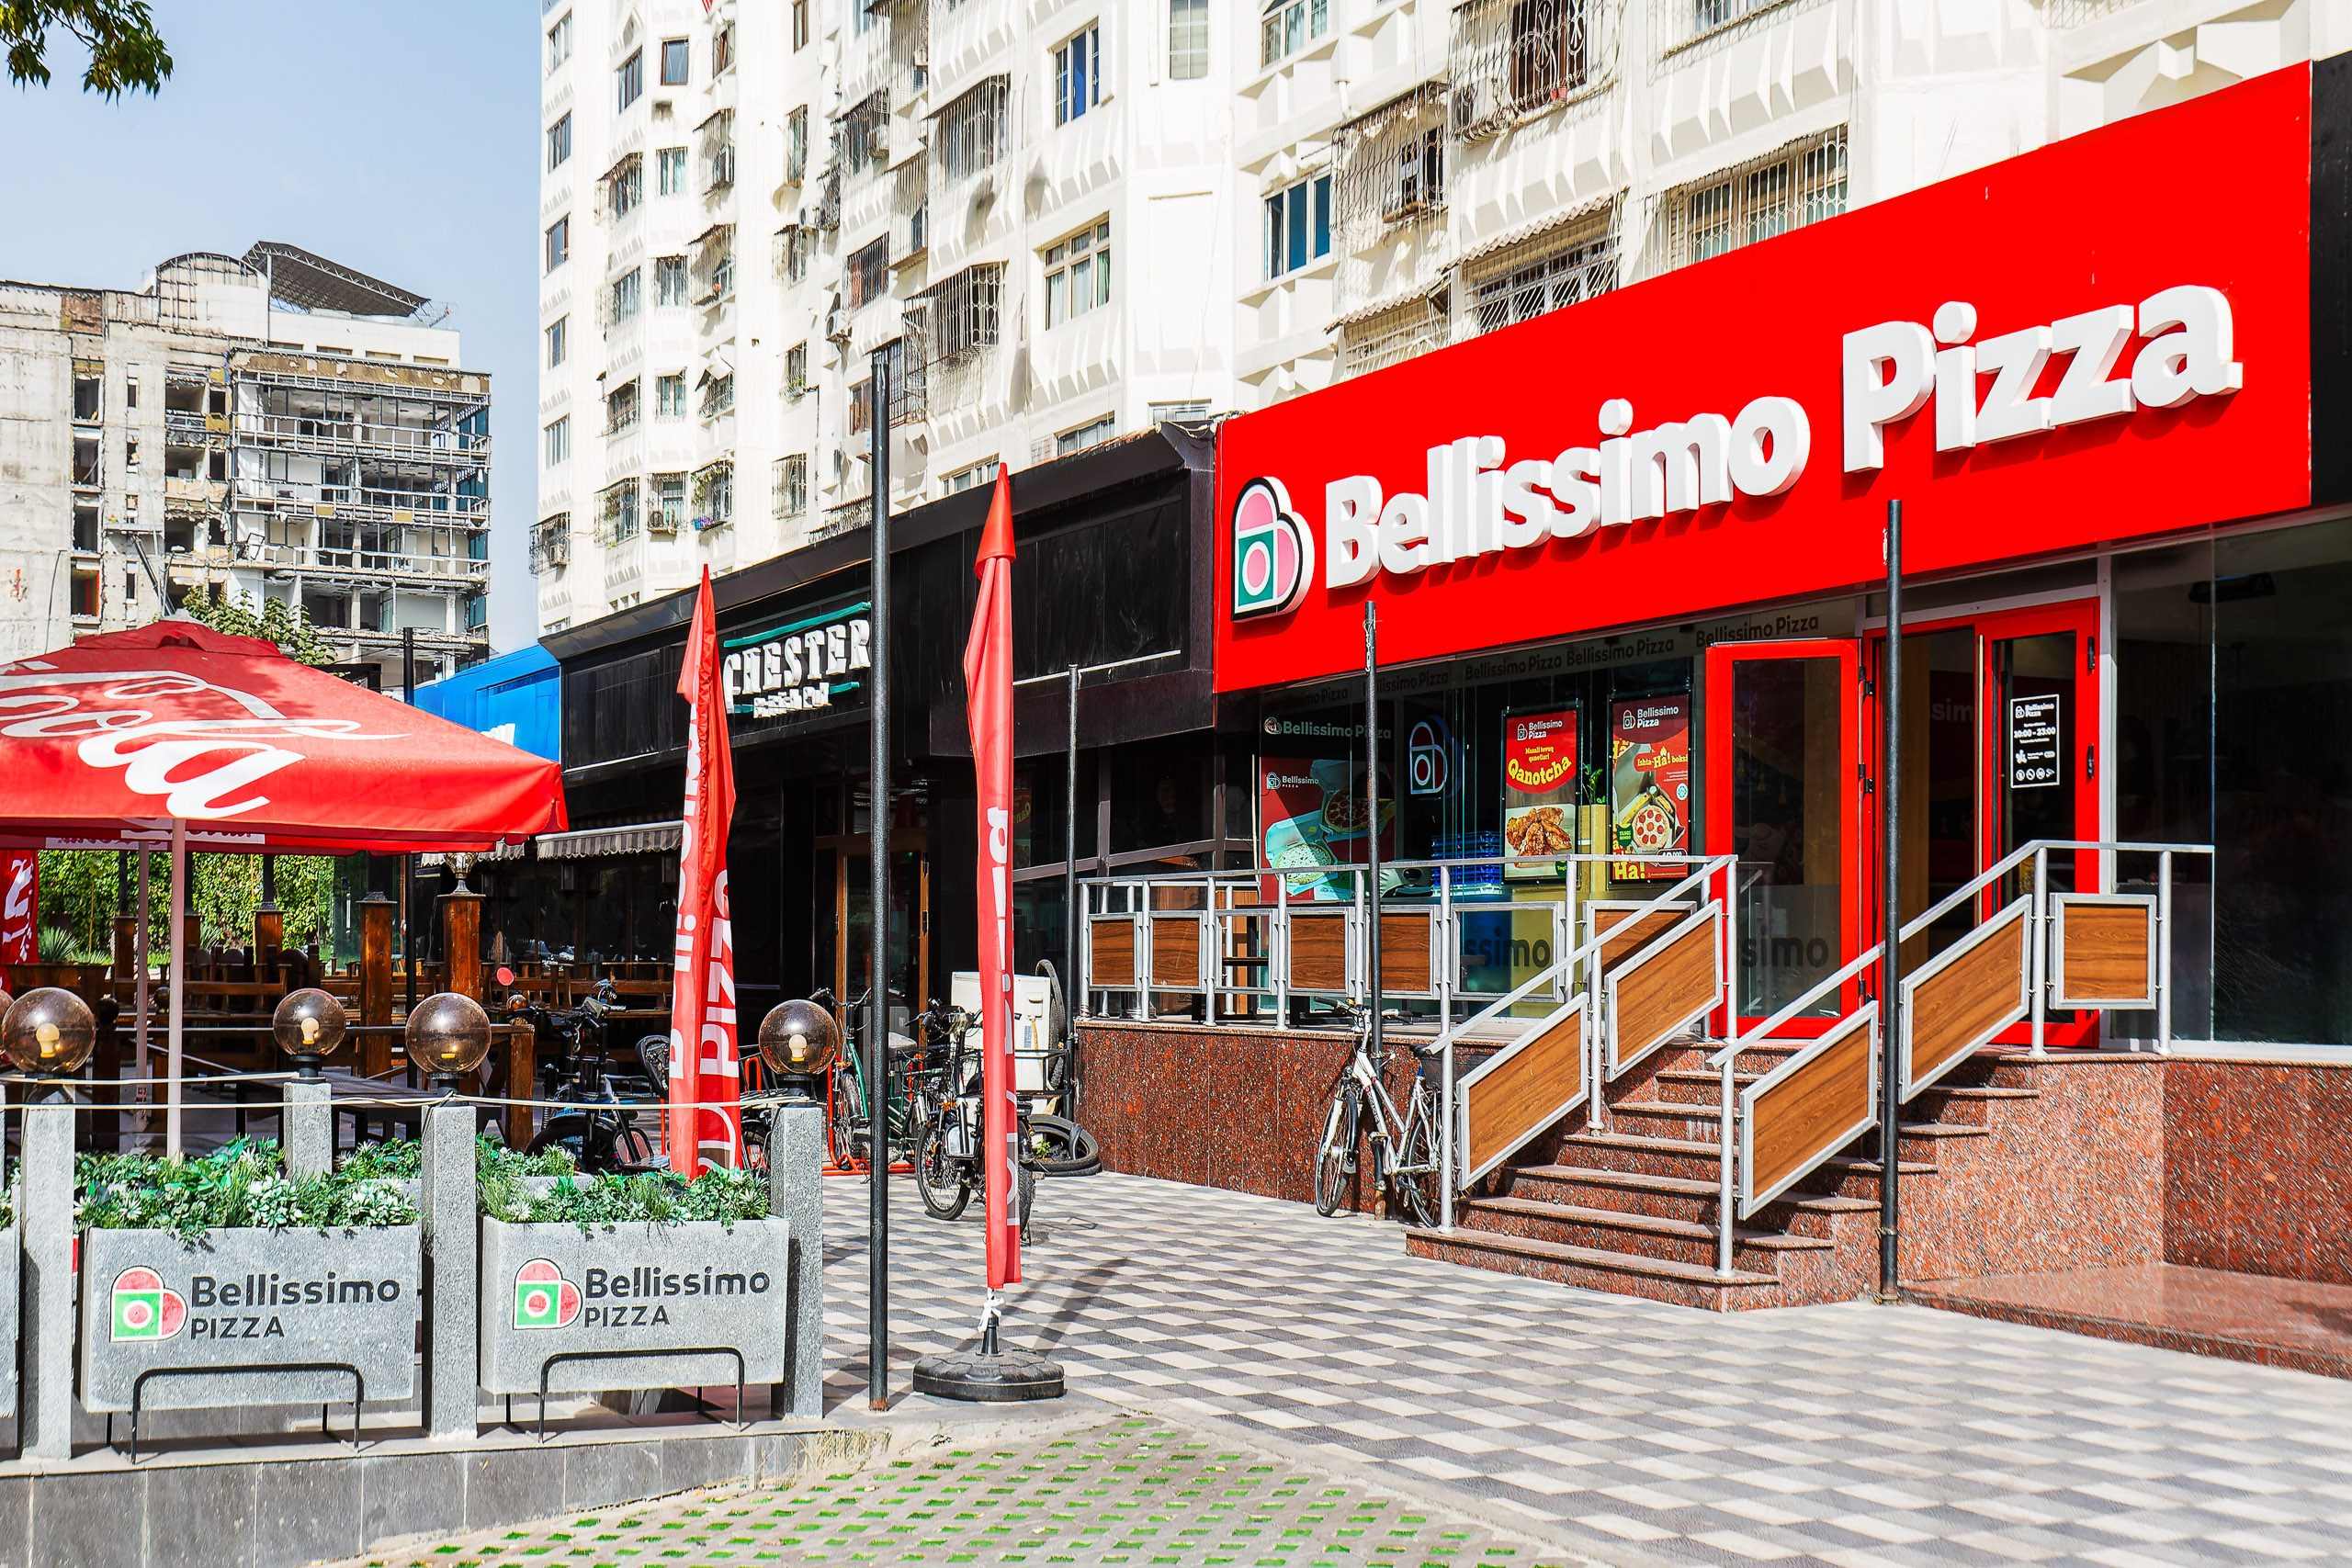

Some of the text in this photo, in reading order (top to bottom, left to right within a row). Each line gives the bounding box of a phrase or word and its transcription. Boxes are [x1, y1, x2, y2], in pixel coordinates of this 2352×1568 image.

[1326, 285, 2244, 589] Bellissimo Pizza
[1696, 615, 1819, 647] Bellissimo Pizza
[1566, 637, 1674, 667] Bellissimo Pizza
[723, 619, 871, 714] CHESTER
[1465, 655, 1562, 681] Bellissimo Pizza
[1363, 671, 1449, 696] llissimo Pizza
[1636, 717, 1659, 728] Pizza
[1637, 705, 1679, 718] Bellissimo
[1283, 721, 1392, 739] Bellissimo Piza
[1528, 719, 1563, 731] Bellissimo
[1528, 730, 1547, 740] Pizza
[1282, 775, 1319, 784] Bellissimo
[1508, 755, 1572, 786] Qanotcha
[1613, 861, 1645, 880] Ha!
[191, 1271, 401, 1307] Bellissimo
[585, 1266, 770, 1299] Bellissimo
[190, 1315, 286, 1340] PIZZA
[584, 1305, 671, 1328] PIZZA
